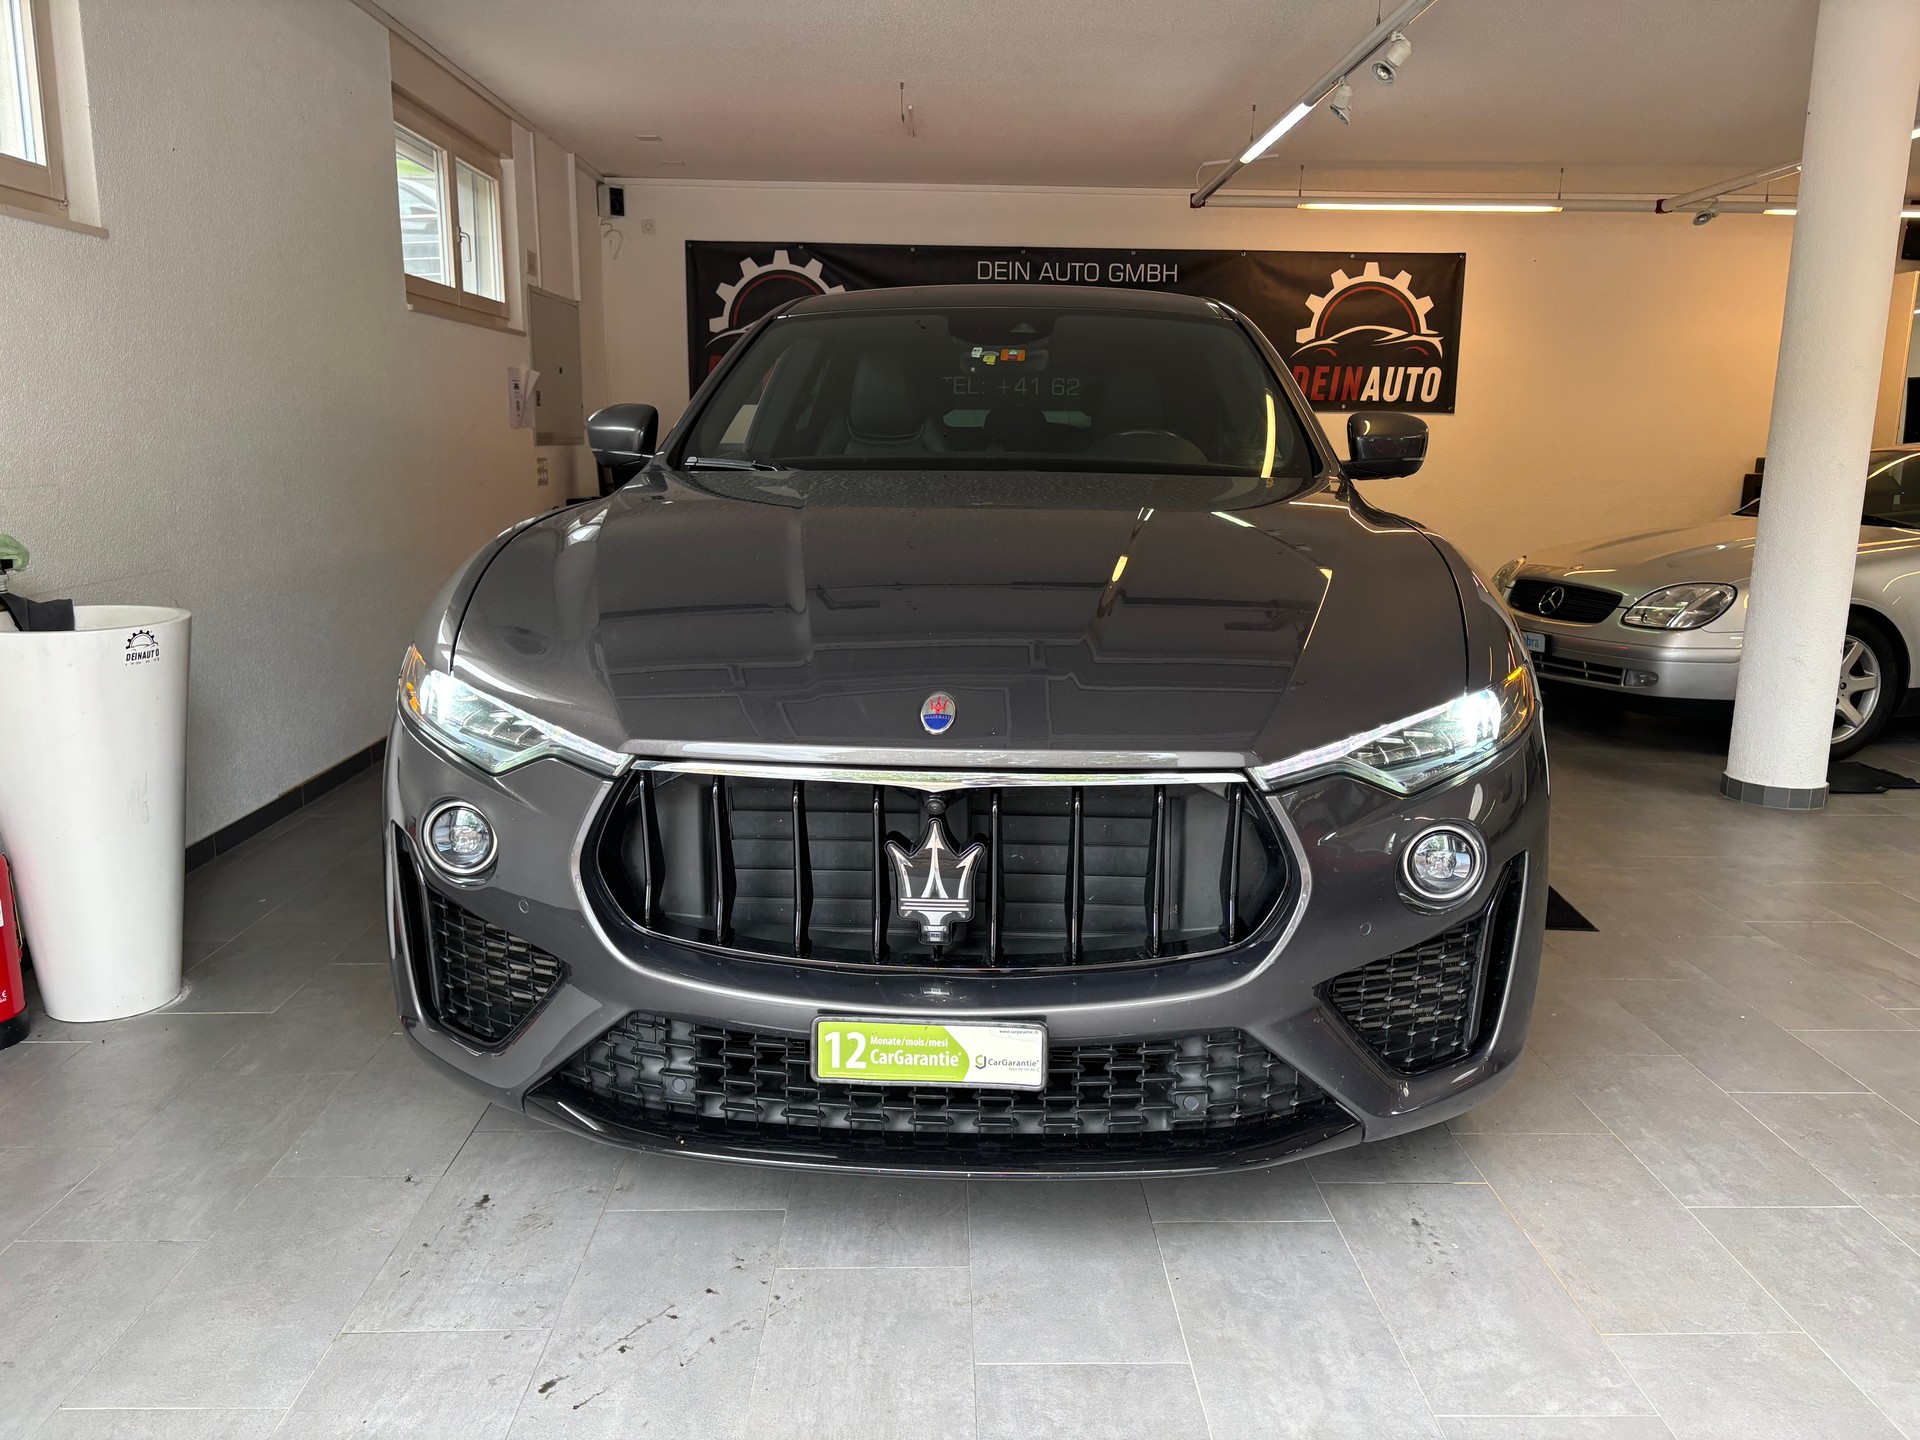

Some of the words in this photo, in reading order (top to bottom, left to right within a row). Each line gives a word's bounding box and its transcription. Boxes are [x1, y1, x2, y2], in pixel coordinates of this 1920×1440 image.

[977, 261, 1030, 280] DEIN
[1039, 262, 1100, 281] AUTO
[1108, 263, 1178, 282] GMBH
[997, 377, 1040, 395] +41
[1051, 378, 1080, 396] 62
[1523, 635, 1539, 648] bra
[824, 1031, 867, 1069] 12
